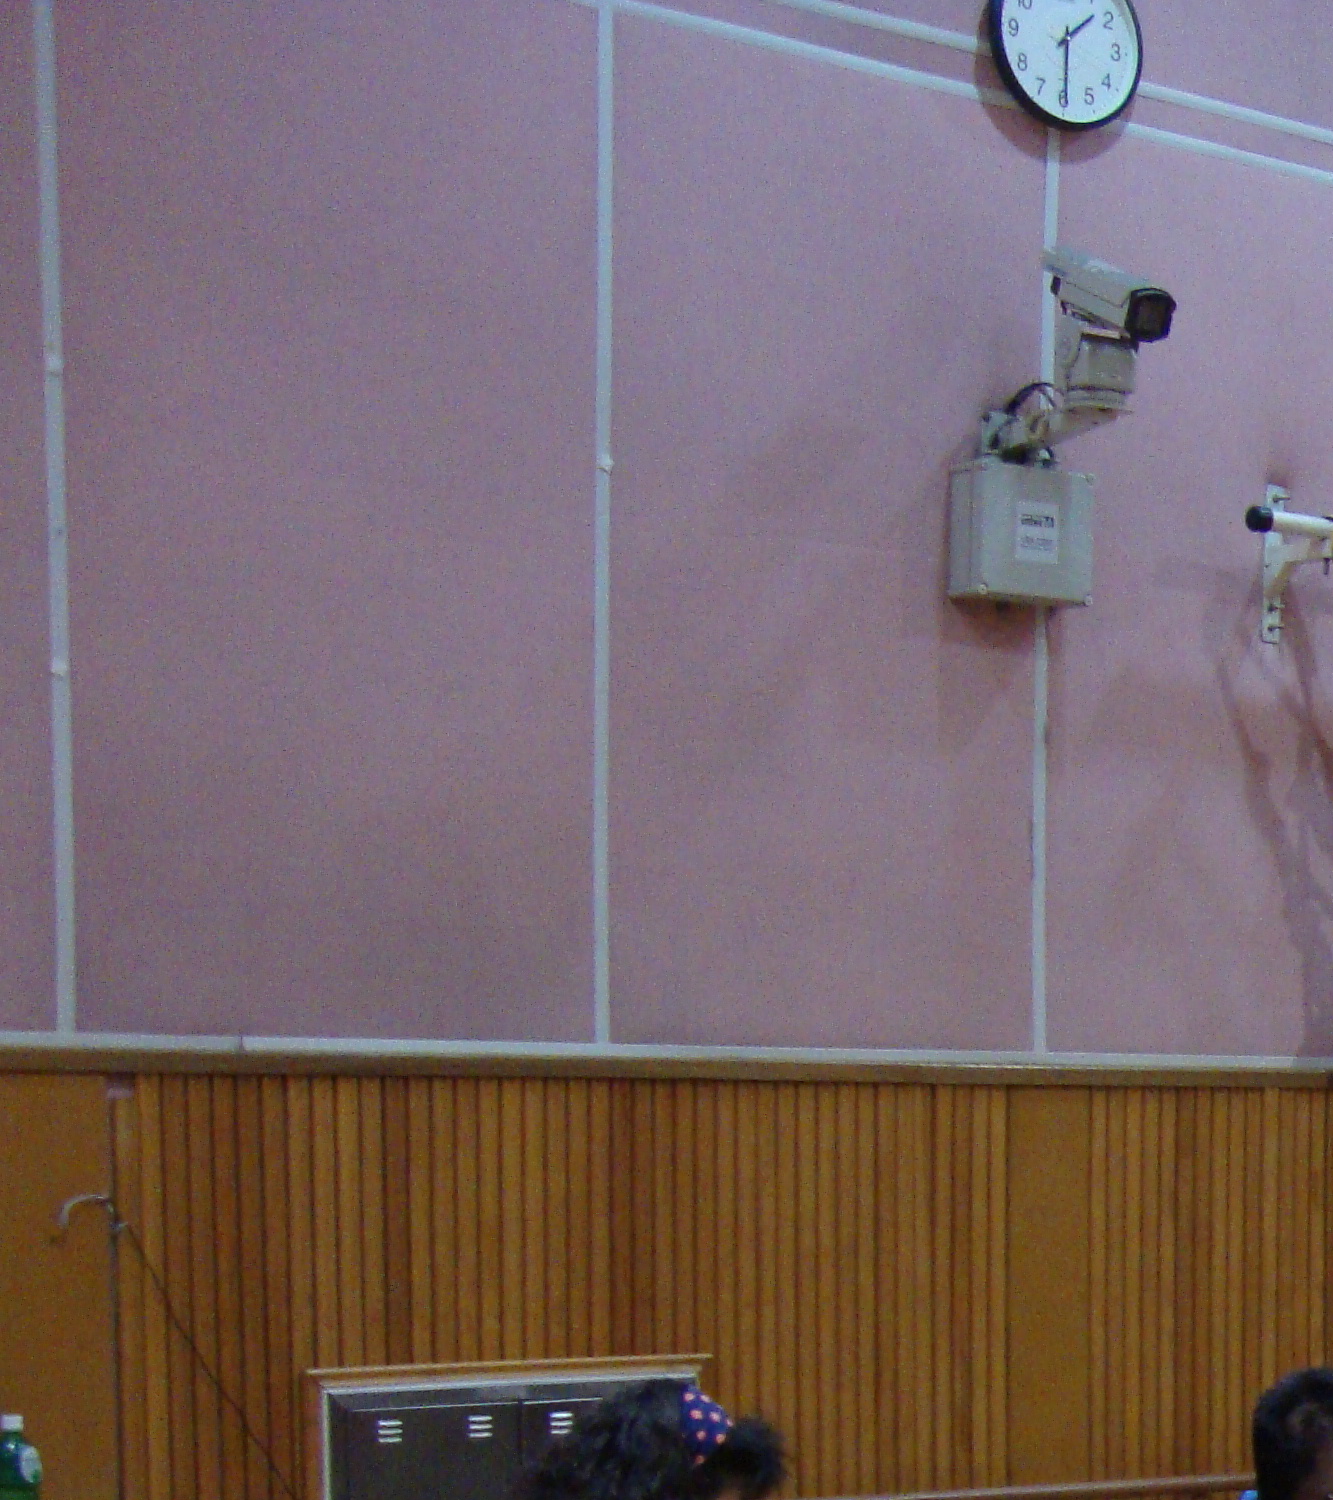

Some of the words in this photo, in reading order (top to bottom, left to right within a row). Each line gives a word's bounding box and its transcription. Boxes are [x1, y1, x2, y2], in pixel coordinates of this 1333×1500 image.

[1008, 18, 1019, 37] 9
[1103, 11, 1114, 31] 2
[1017, 52, 1028, 71] 8
[1111, 43, 1121, 62] 3
[1035, 77, 1046, 96] 7
[1101, 73, 1111, 91] 4
[1084, 87, 1095, 106] 5
